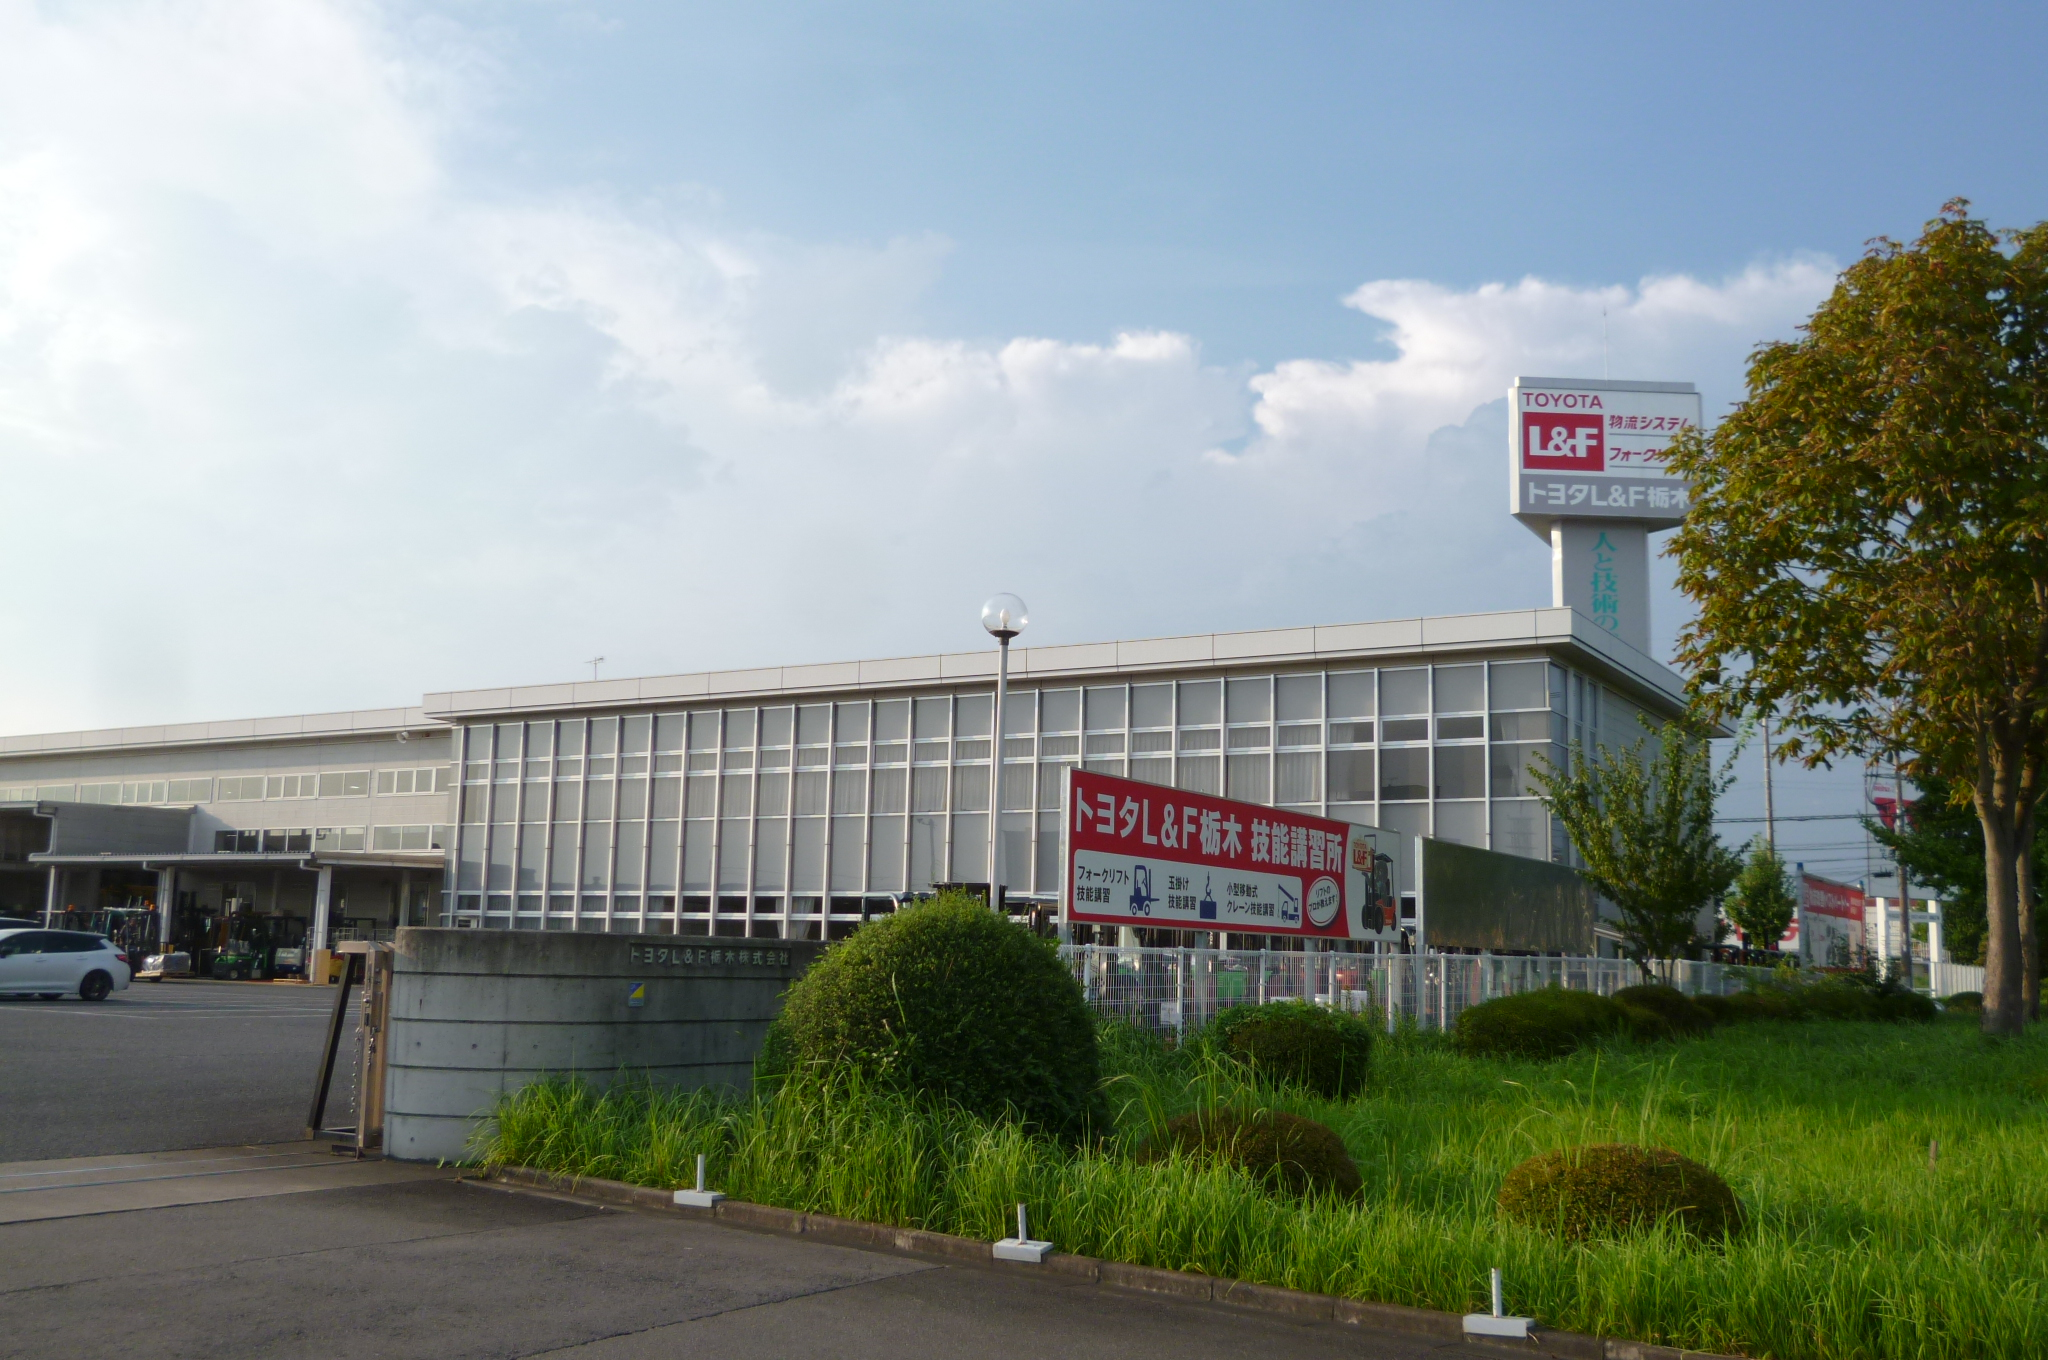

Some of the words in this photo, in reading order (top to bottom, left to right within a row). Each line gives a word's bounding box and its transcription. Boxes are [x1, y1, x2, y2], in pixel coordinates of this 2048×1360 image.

[1522, 392, 1603, 409] TOYOTA
[1528, 425, 1599, 458] L&F
[1529, 482, 1690, 509] トヨタL&F栃木
[1075, 787, 1242, 859] トヨタL&F栃木
[1250, 818, 1343, 874] 技能講習所
[1352, 848, 1368, 866] L&F
[1077, 865, 1130, 886] フォークリフト
[1168, 875, 1189, 892] 玉掛け
[1076, 885, 1111, 904] 技能講習
[1226, 881, 1259, 898] 小型移動式
[1168, 895, 1197, 911] 技能講習
[1226, 900, 1275, 917] クレーン技能講習
[630, 947, 790, 966] トヨタL&F栃木株式会社
